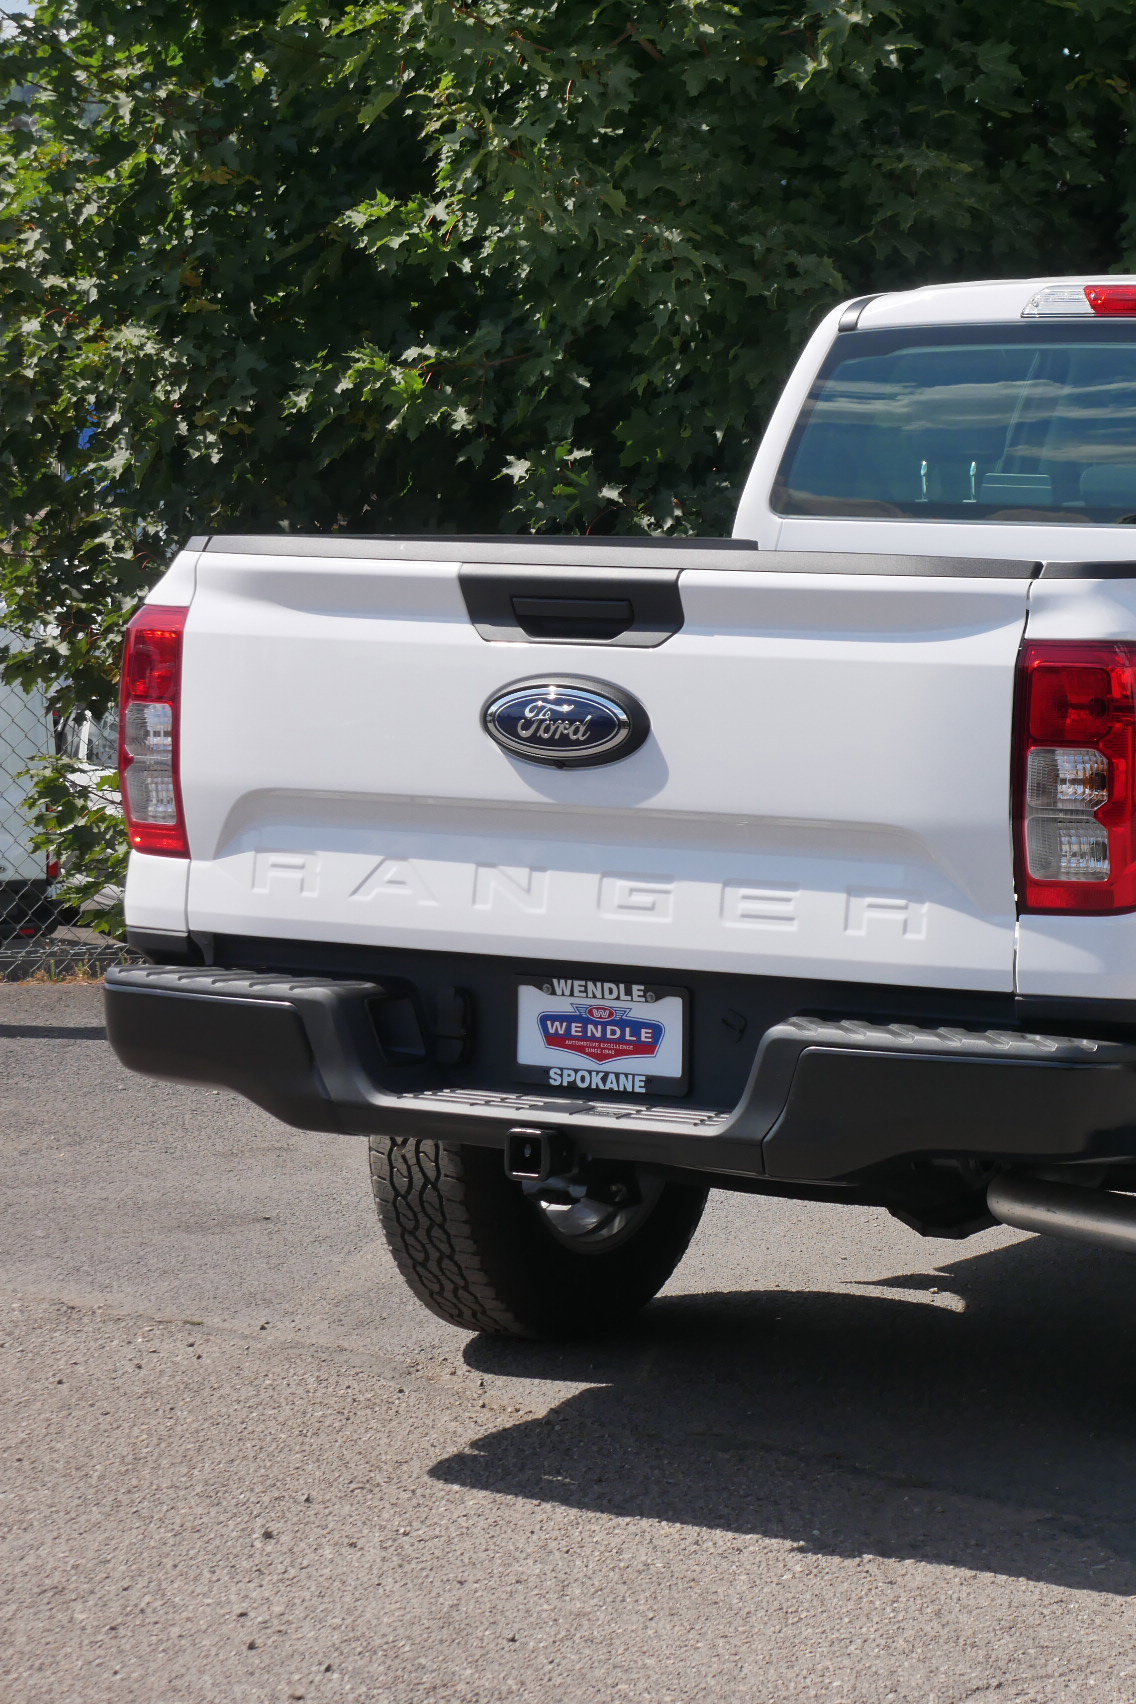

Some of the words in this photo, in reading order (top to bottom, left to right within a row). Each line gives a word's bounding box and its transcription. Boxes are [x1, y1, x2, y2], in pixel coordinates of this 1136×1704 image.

[517, 702, 592, 741] Ford
[251, 847, 927, 939] RANGER
[552, 978, 646, 1002] WENDLE
[546, 1020, 653, 1041] WENDLE
[565, 1040, 600, 1048] AUTOMOTIVE
[600, 1042, 634, 1051] EXCELLENCE
[549, 1068, 646, 1093] SPOKANE
